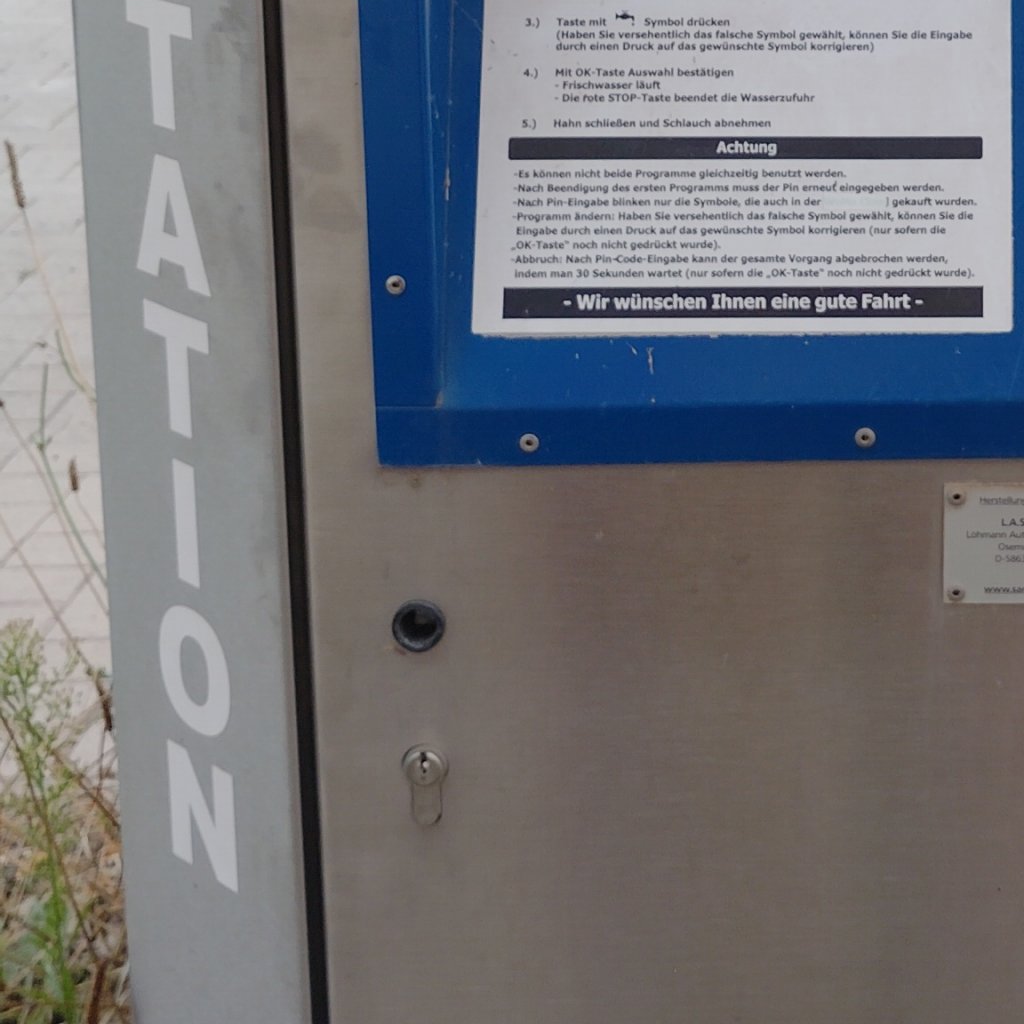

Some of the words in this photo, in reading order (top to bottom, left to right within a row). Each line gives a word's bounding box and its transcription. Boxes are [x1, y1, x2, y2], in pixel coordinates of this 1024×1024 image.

[522, 118, 536, 130] 5.)
[553, 118, 582, 129] Hahn
[585, 118, 636, 129] schließen
[639, 118, 659, 129] und
[663, 118, 711, 129] Schlauch
[714, 118, 771, 128] abnehmen
[716, 140, 777, 156] Achtung
[533, 168, 571, 179] können
[575, 168, 601, 179] nicht
[604, 168, 632, 179] beide
[635, 168, 696, 181] Programme
[699, 168, 758, 181] gleichzeitig
[762, 168, 801, 179] benutzt
[805, 168, 846, 179] werden.
[576, 293, 610, 310] Wir
[613, 293, 707, 310] wünschen
[712, 293, 766, 309] Ihnen
[771, 293, 811, 309] eine
[814, 294, 857, 313] gute
[862, 293, 911, 309] Fahrt
